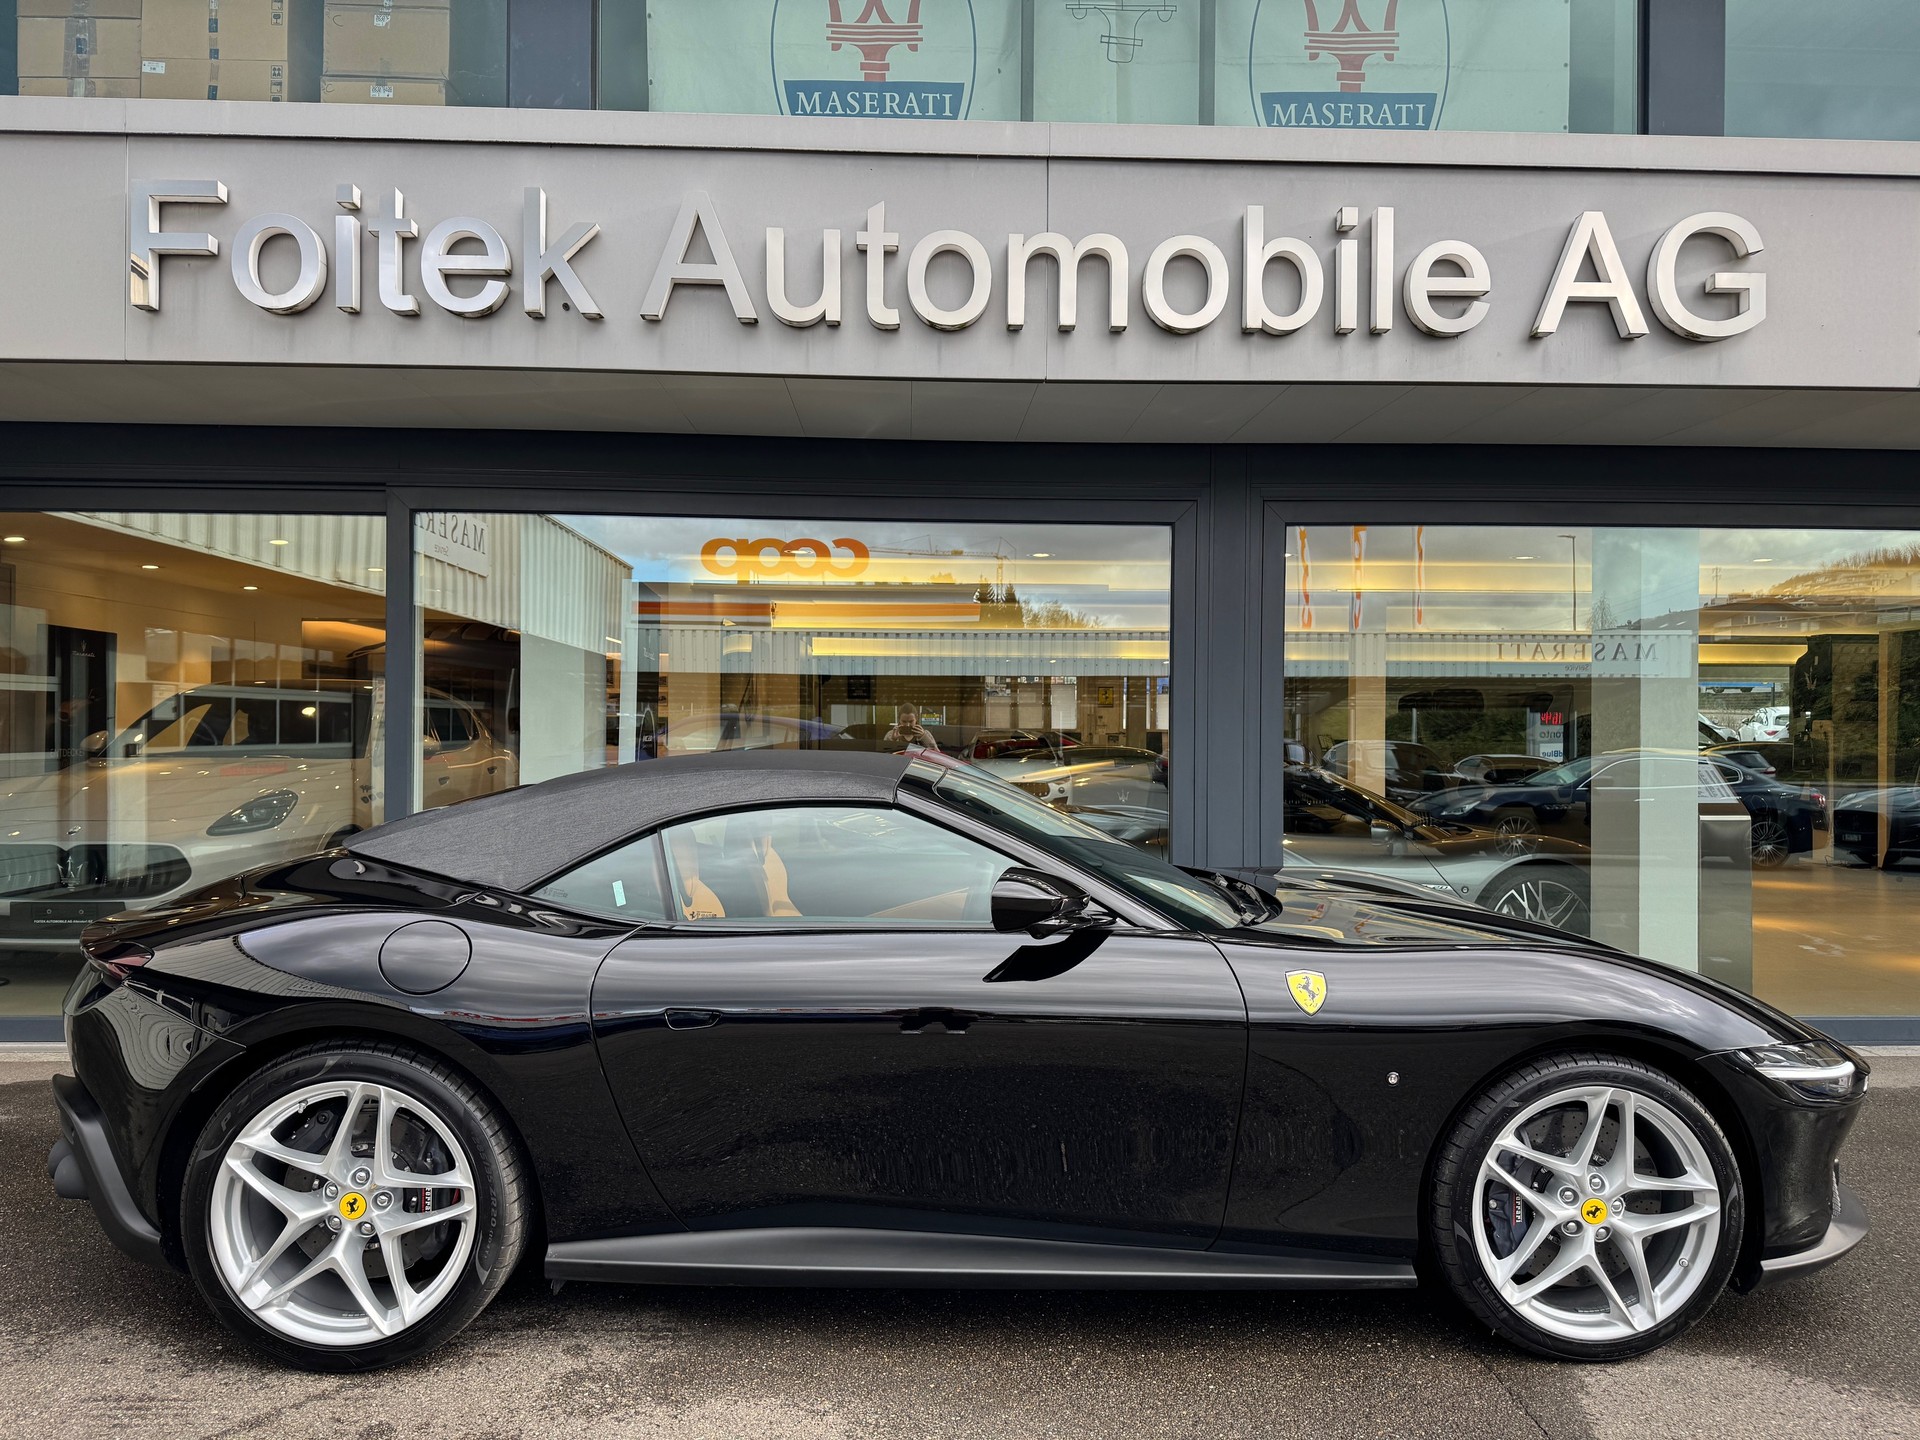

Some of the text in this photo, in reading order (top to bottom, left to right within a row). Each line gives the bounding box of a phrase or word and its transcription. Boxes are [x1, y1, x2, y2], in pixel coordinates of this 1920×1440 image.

[795, 91, 953, 117] MASERATI
[1272, 102, 1426, 128] MASERATI
[130, 179, 1767, 343] Foitek Automobile AG
